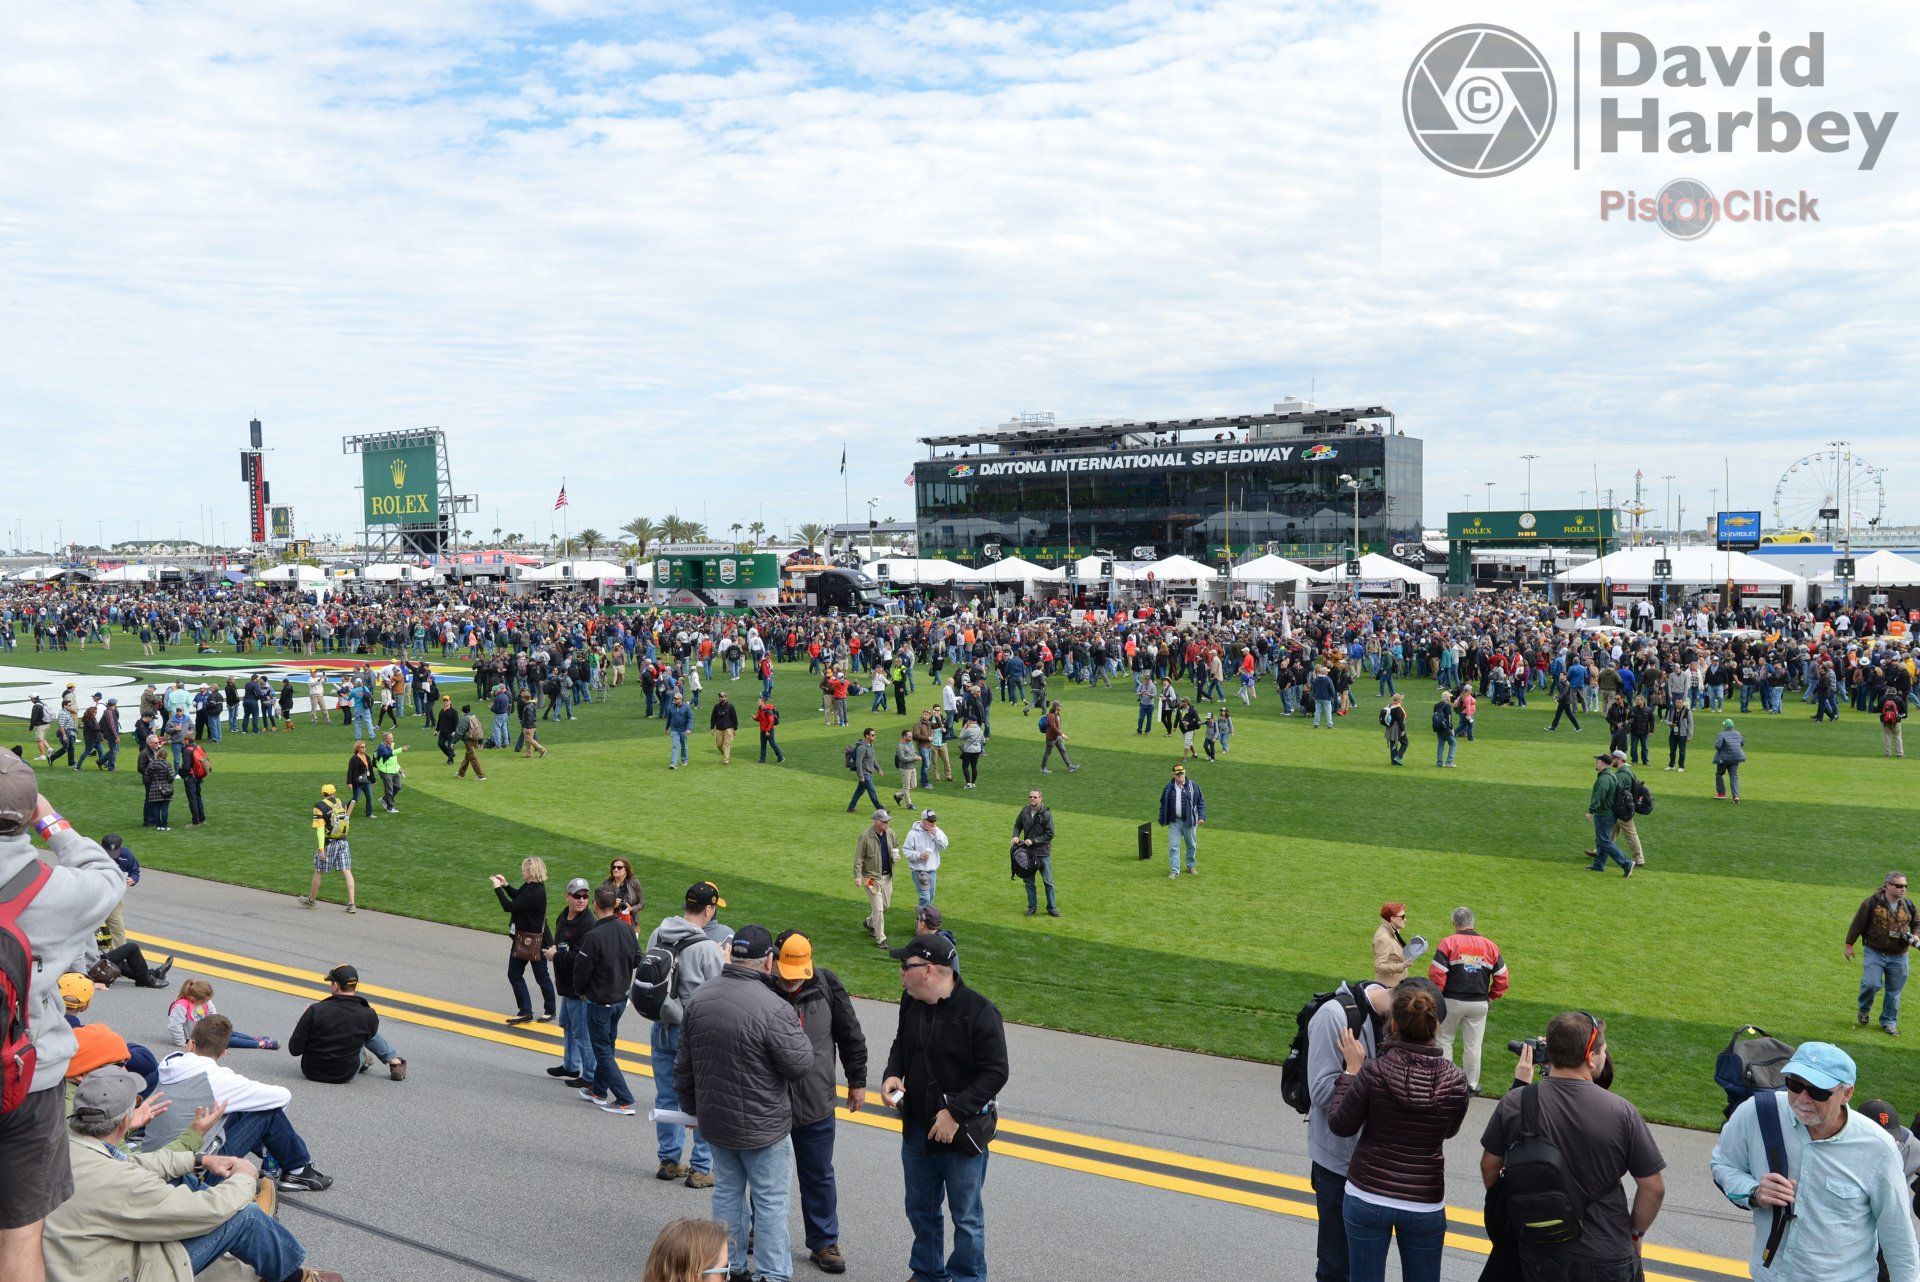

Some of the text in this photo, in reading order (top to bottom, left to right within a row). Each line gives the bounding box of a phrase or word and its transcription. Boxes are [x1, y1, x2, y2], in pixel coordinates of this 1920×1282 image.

[979, 446, 1294, 476] DAYTONA INTERNATIONAL SPEEDWAY
[371, 494, 430, 515] ROLEX
[273, 525, 290, 535] ROLE
